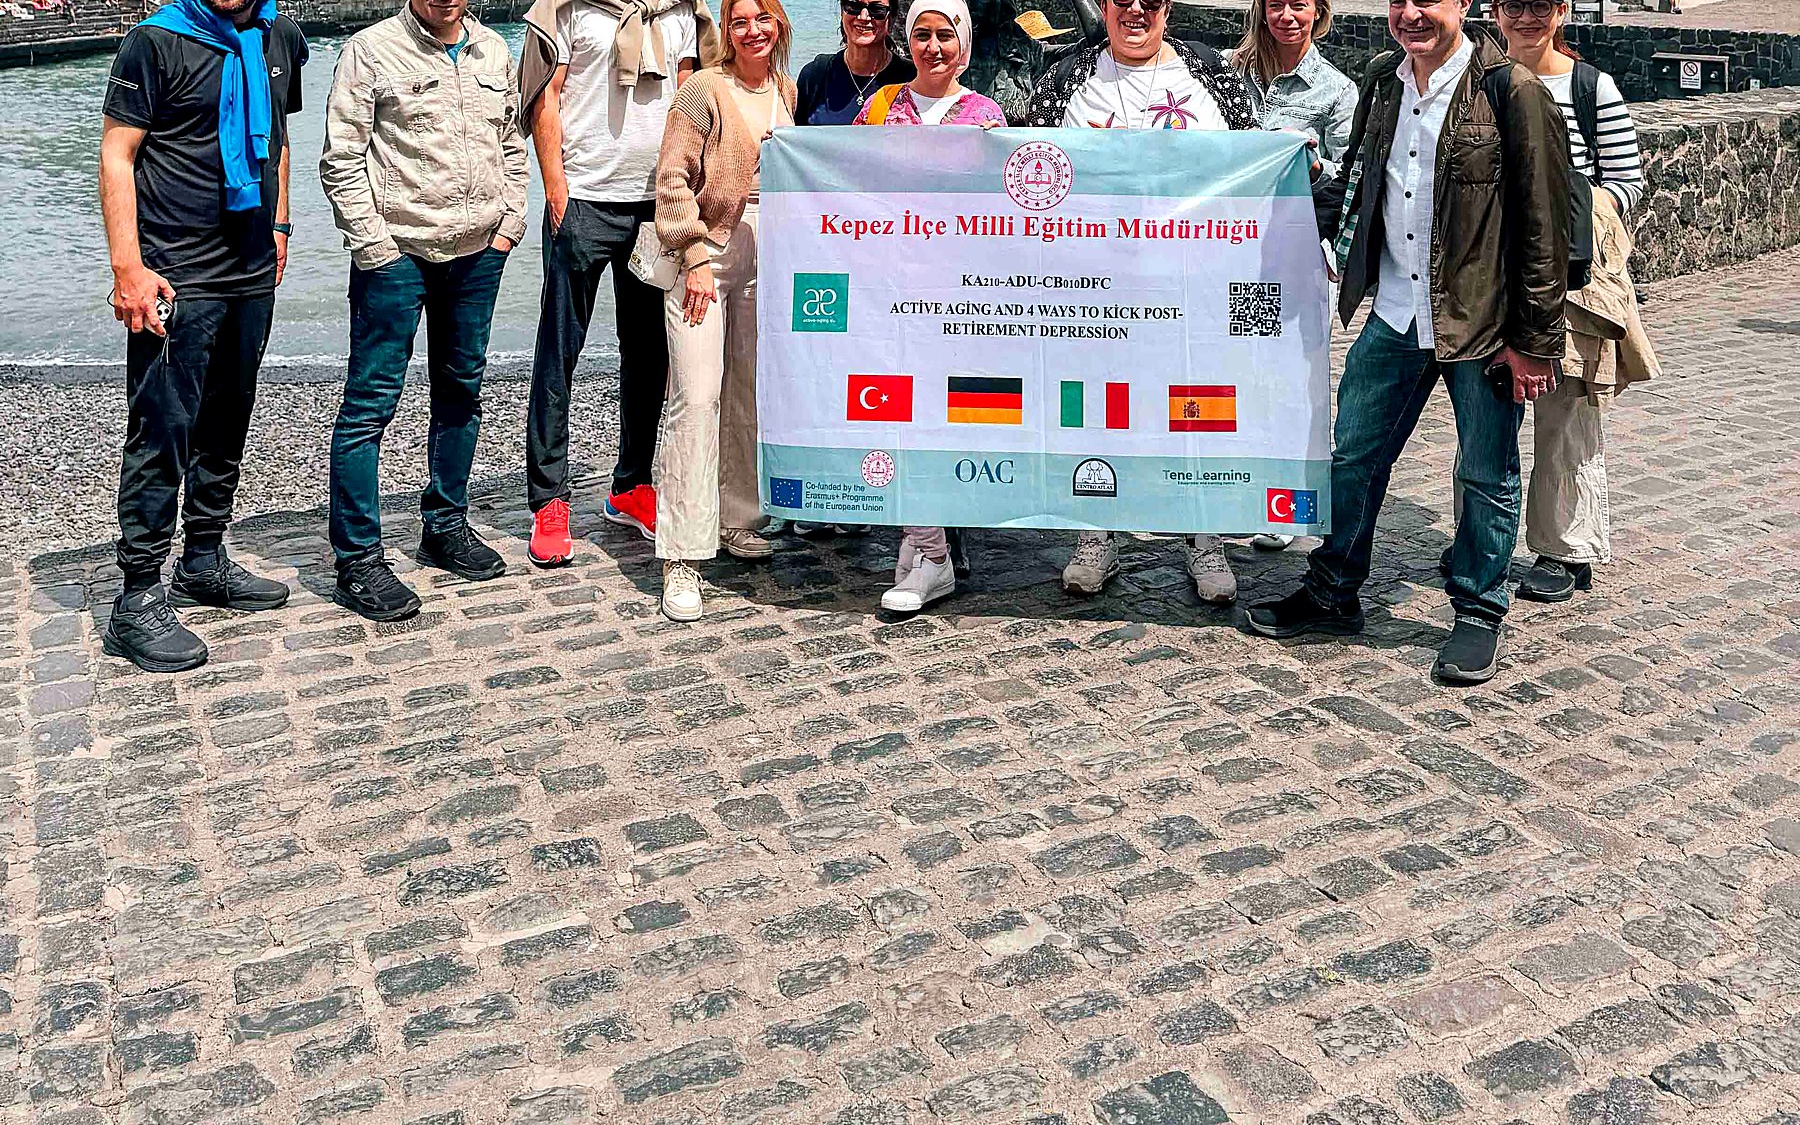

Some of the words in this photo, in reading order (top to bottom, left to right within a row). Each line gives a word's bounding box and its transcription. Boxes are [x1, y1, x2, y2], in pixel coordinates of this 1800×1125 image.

[819, 213, 895, 241] Kepez
[902, 209, 947, 241] İlçe
[954, 214, 1015, 236] Milli
[1022, 215, 1107, 243] Eğitim
[1116, 217, 1259, 245] Müdürlüğü
[961, 274, 1112, 290] KA210-ADU-CB010DFC
[890, 299, 942, 315] ACTİVE
[945, 300, 992, 316] AGİNG
[994, 303, 1024, 317] AND
[1027, 304, 1034, 317] 4
[1037, 305, 1076, 318] WAYS
[1079, 305, 1100, 319] TO
[1102, 304, 1141, 320] KİCK
[1143, 307, 1184, 320] POST-
[942, 320, 1036, 337] RETİREMENT
[1039, 323, 1129, 340] DEPRESSİON
[955, 458, 1014, 484] OAC
[1162, 469, 1193, 481] Tene
[1196, 469, 1251, 483] Learning
[805, 481, 841, 492] Co-funded
[843, 482, 852, 493] by
[853, 482, 865, 492] the
[805, 491, 840, 501] Erasmus+
[841, 493, 884, 504] Programme
[813, 502, 825, 510] the
[825, 503, 861, 512] European
[862, 504, 884, 512] Union
